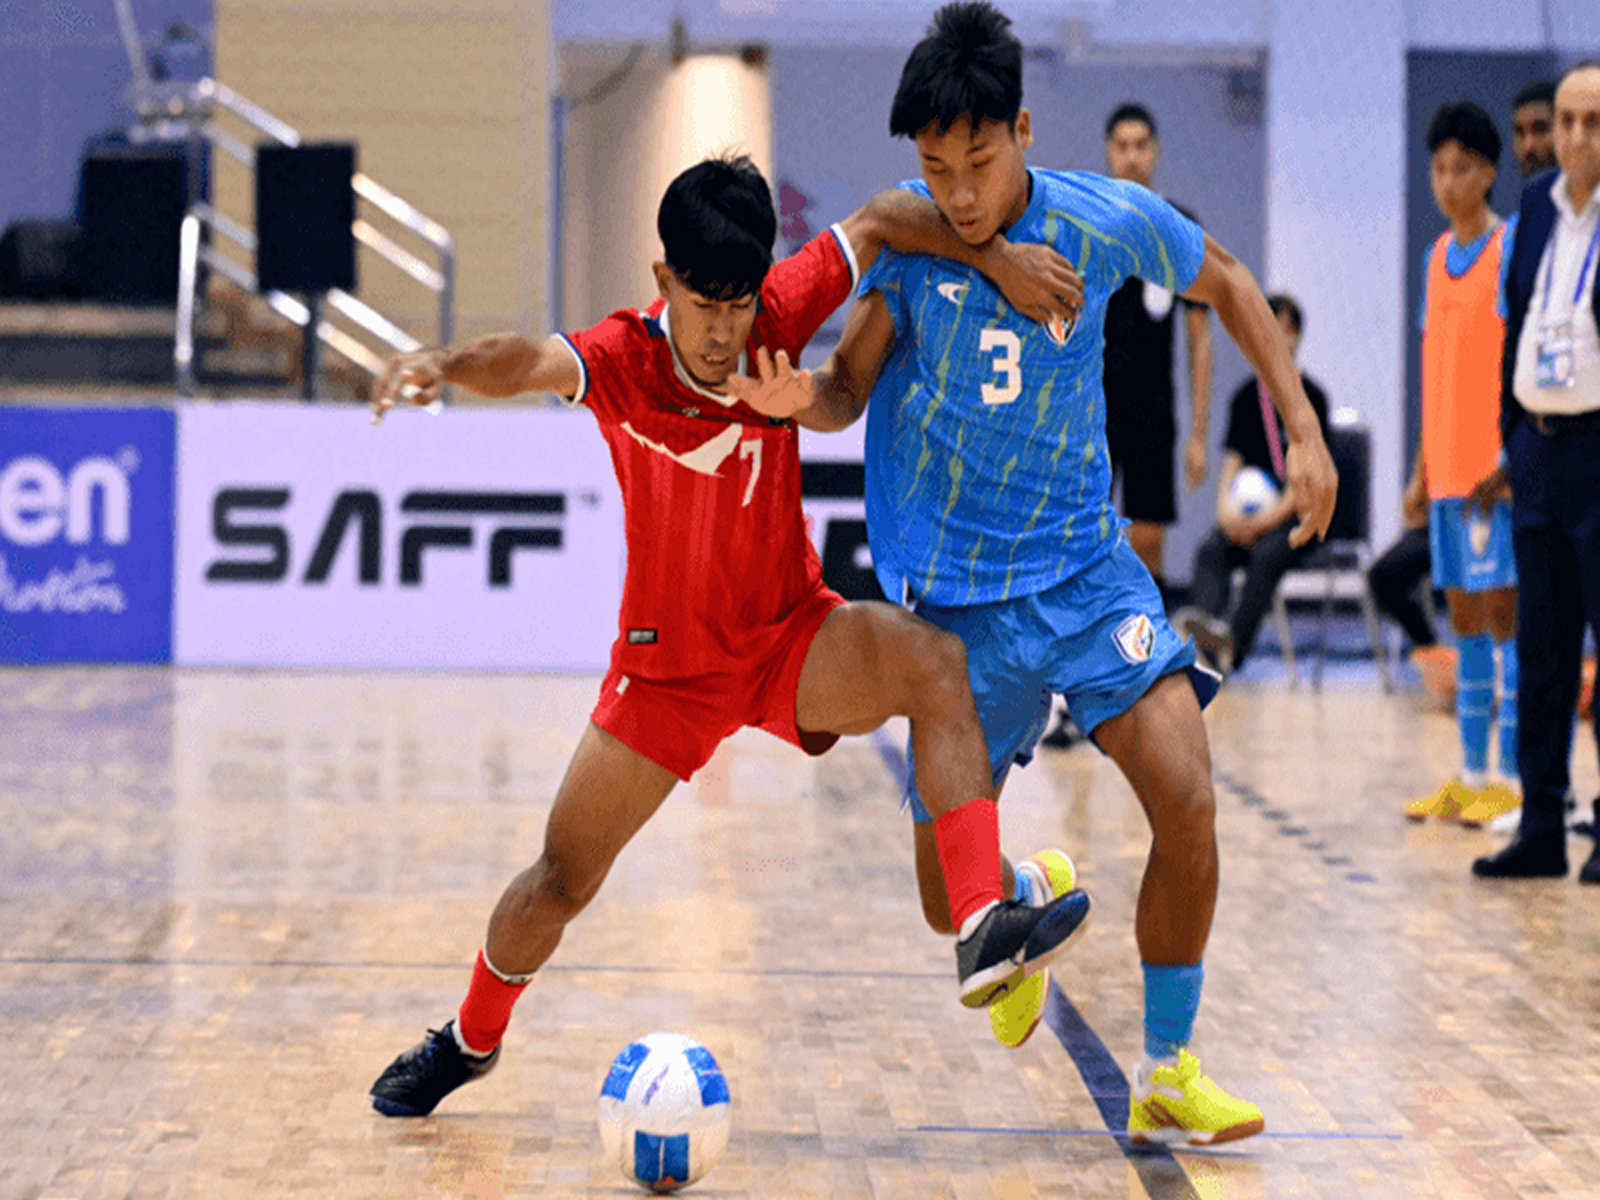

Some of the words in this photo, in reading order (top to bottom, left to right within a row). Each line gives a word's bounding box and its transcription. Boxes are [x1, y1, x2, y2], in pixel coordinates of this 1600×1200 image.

[980, 328, 1022, 405] 3
[740, 437, 763, 507] 7
[205, 487, 567, 587] SAFF
